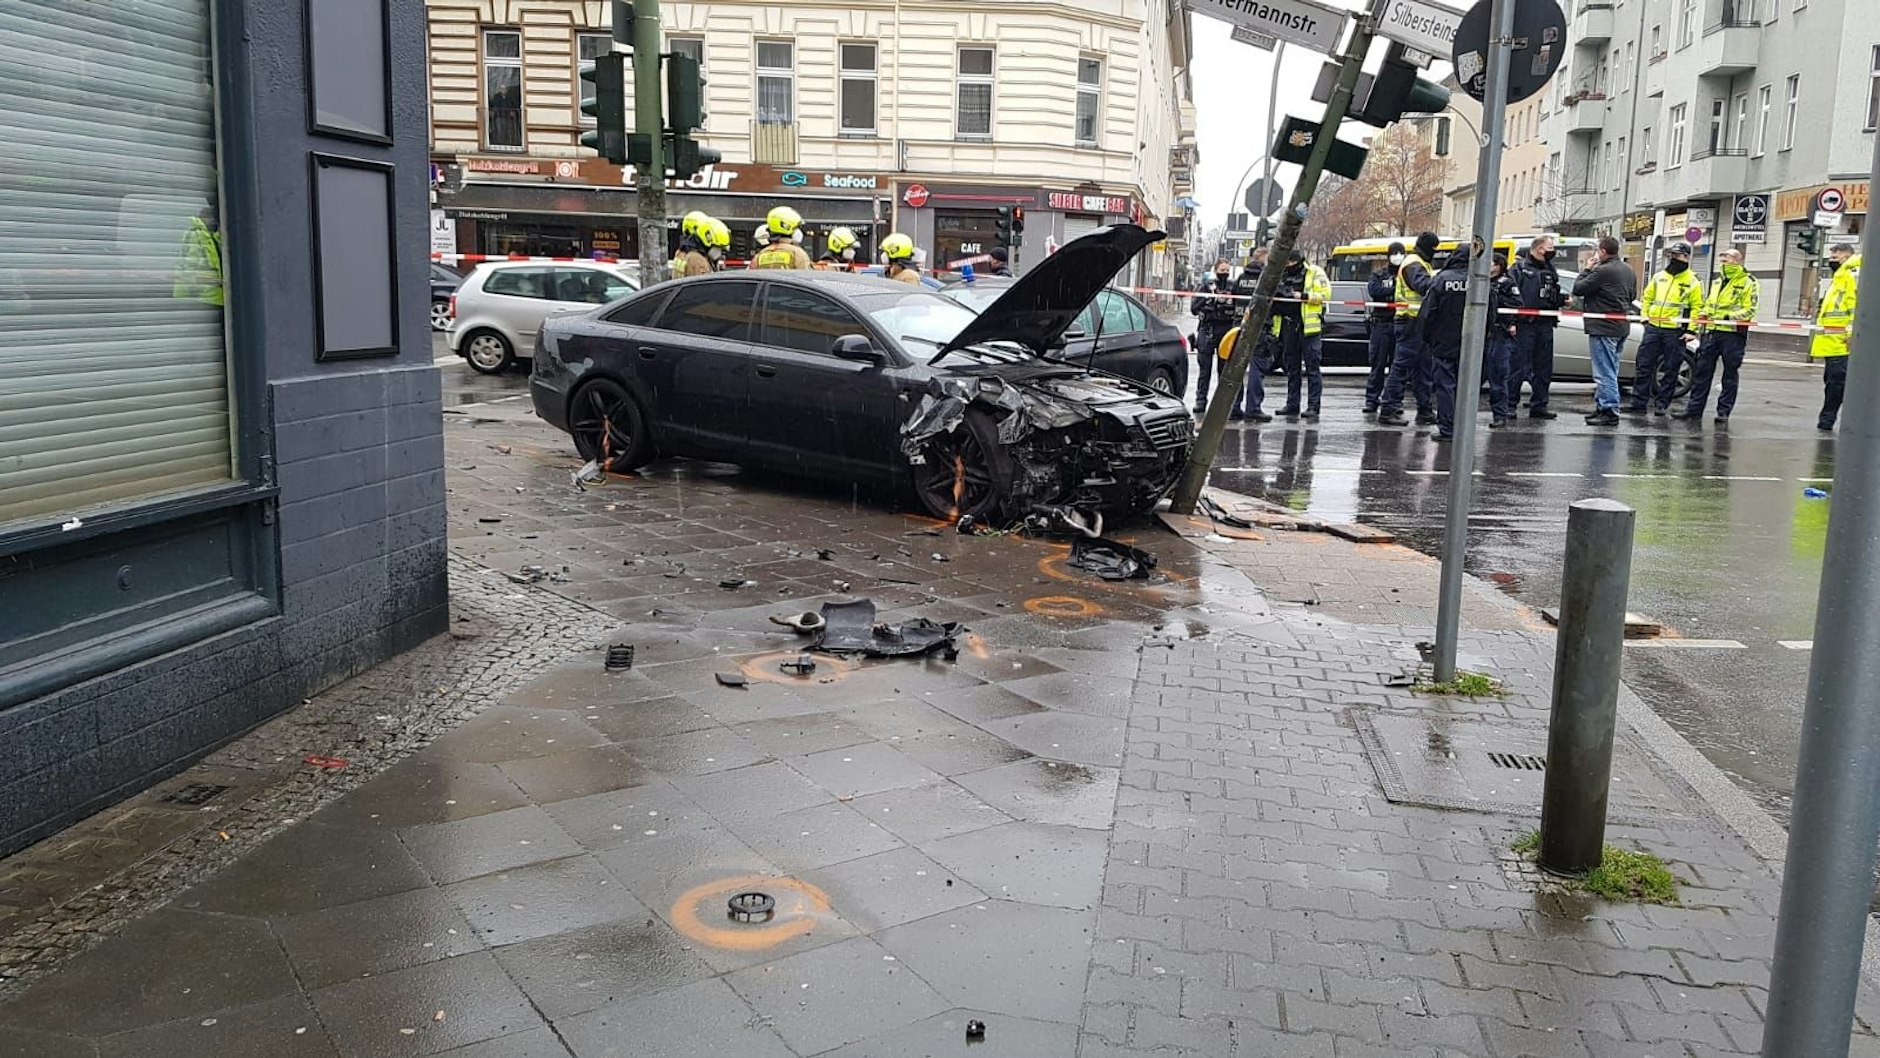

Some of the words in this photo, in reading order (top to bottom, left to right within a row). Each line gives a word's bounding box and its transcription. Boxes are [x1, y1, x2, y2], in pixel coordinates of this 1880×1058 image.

[1209, 0, 1316, 35] ermannstr.
[1391, 2, 1457, 42] Silbersteins
[824, 174, 876, 188] Seafood
[1106, 198, 1124, 212] BAR
[960, 243, 981, 254] CAFE
[1445, 280, 1469, 292] POLI
